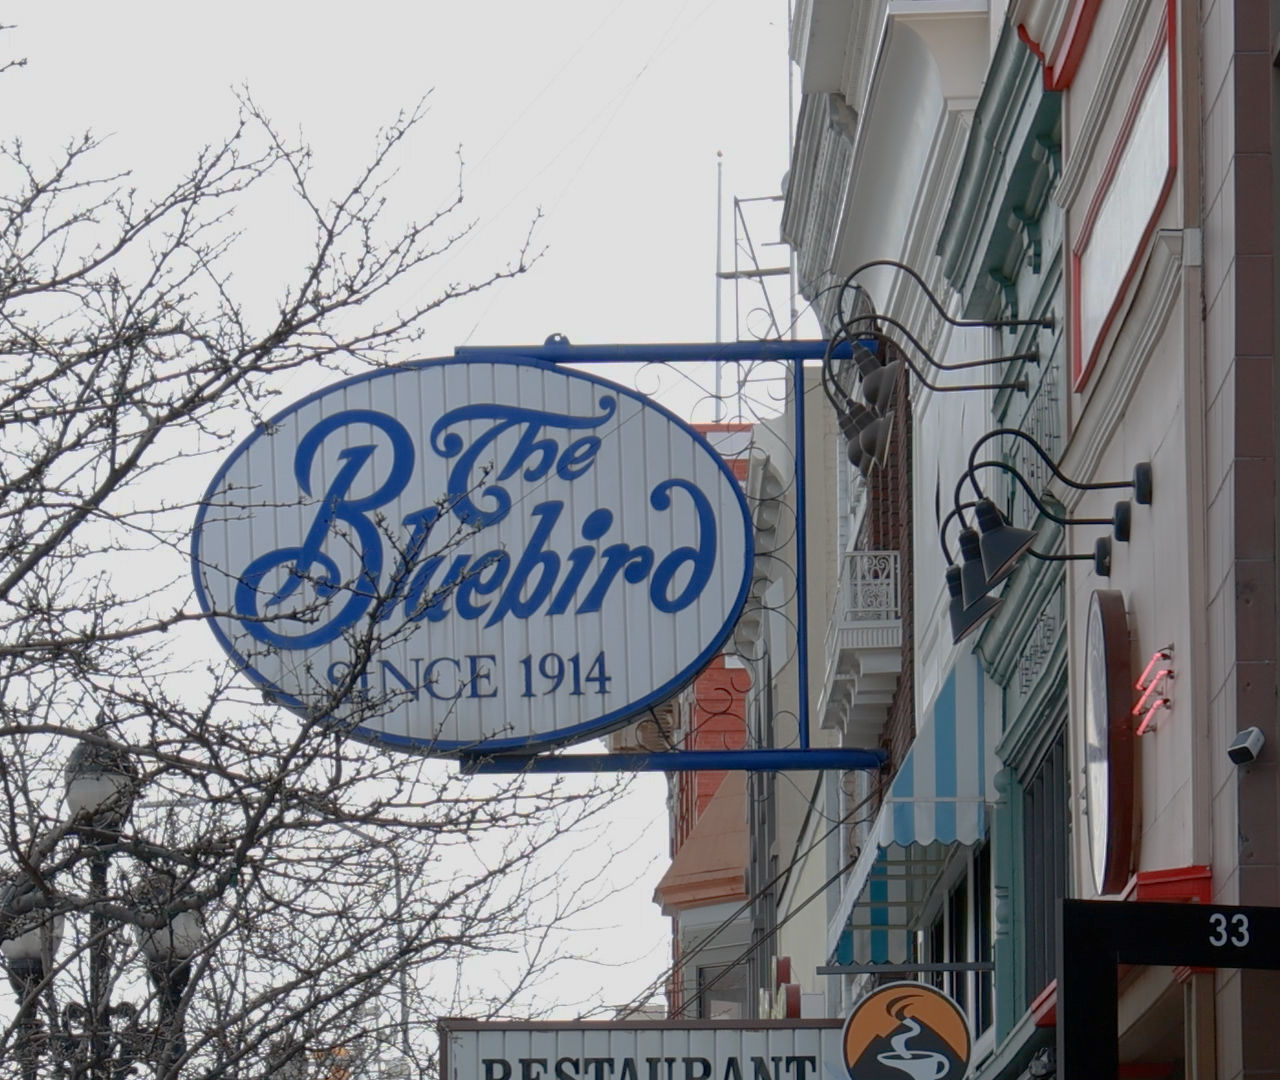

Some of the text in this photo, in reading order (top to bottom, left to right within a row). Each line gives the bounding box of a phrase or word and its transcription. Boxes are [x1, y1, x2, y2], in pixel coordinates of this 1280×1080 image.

[430, 396, 616, 528] The
[235, 409, 717, 650] Bluebird
[328, 651, 611, 703] SINCE 1914
[1209, 913, 1250, 947] 33
